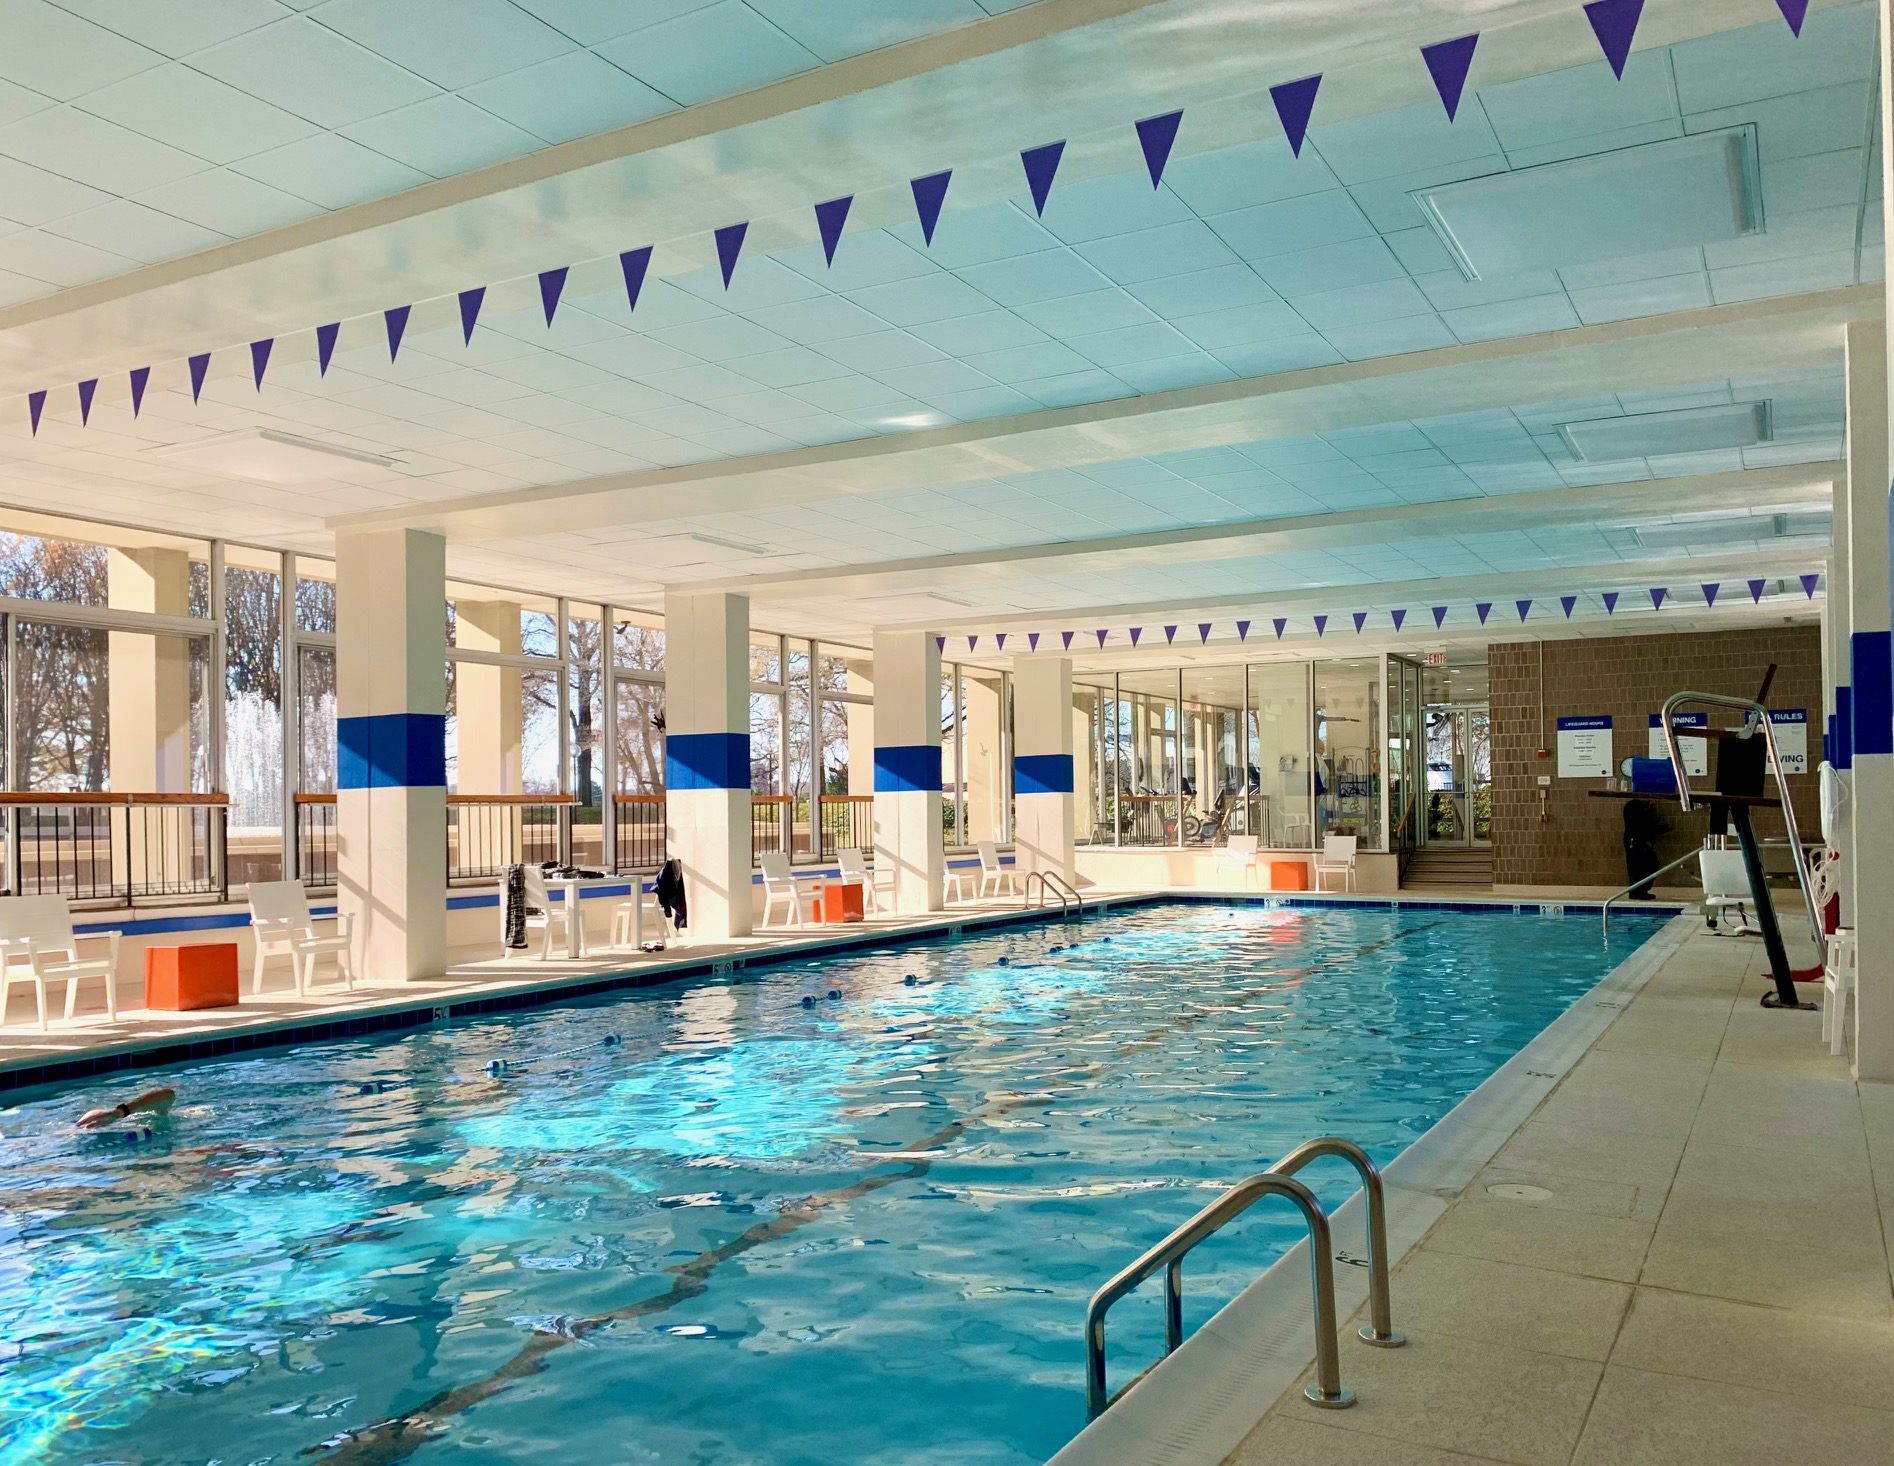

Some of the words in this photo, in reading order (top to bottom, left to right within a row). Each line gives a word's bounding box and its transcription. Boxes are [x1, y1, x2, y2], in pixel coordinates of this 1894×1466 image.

[1428, 653, 1444, 665] EXIT
[1659, 716, 1697, 724] RNING
[1774, 712, 1803, 721] RULES
